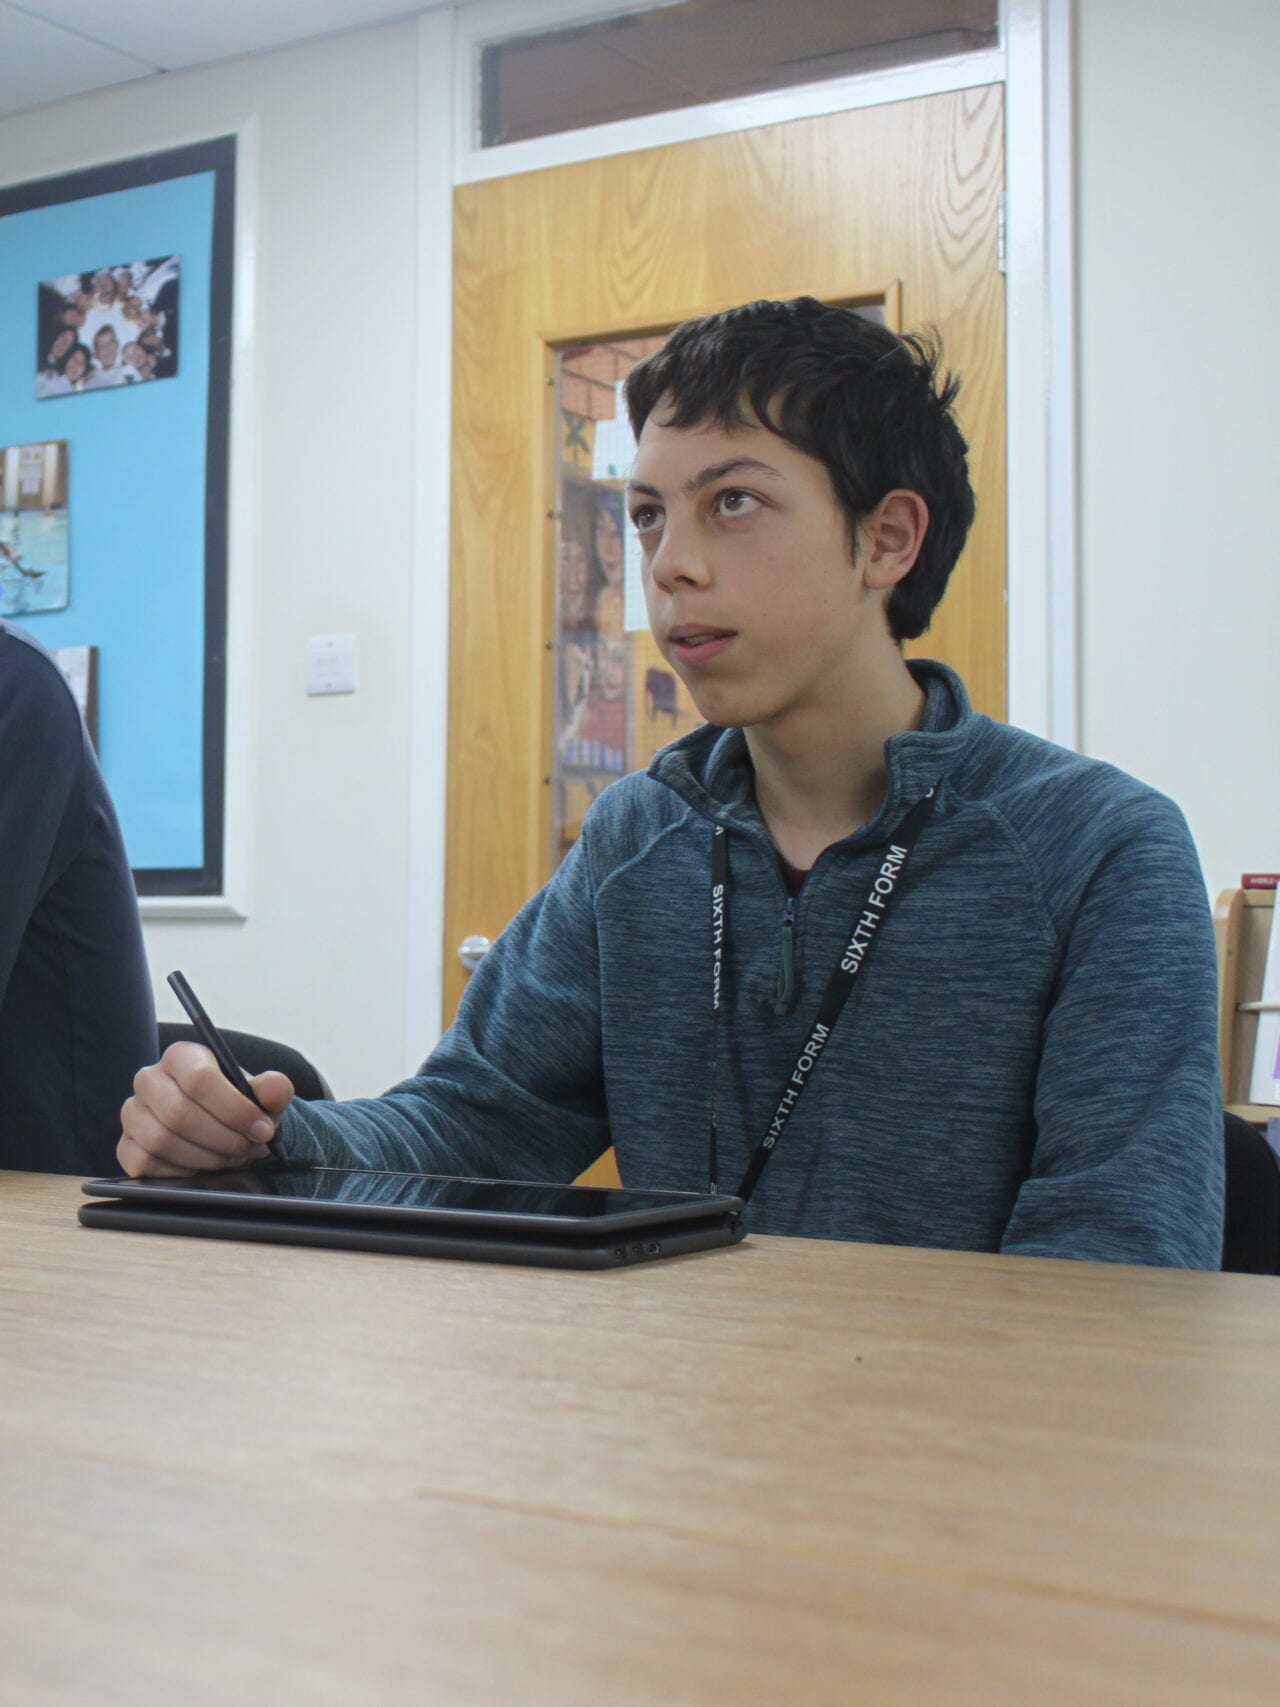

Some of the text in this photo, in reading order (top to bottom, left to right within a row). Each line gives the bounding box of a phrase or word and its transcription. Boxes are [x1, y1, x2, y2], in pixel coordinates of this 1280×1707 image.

[712, 884, 724, 1010] SIXTH FORM
[840, 844, 908, 974] SIXTH FORM
[762, 1023, 831, 1149] SIXTH FORM
